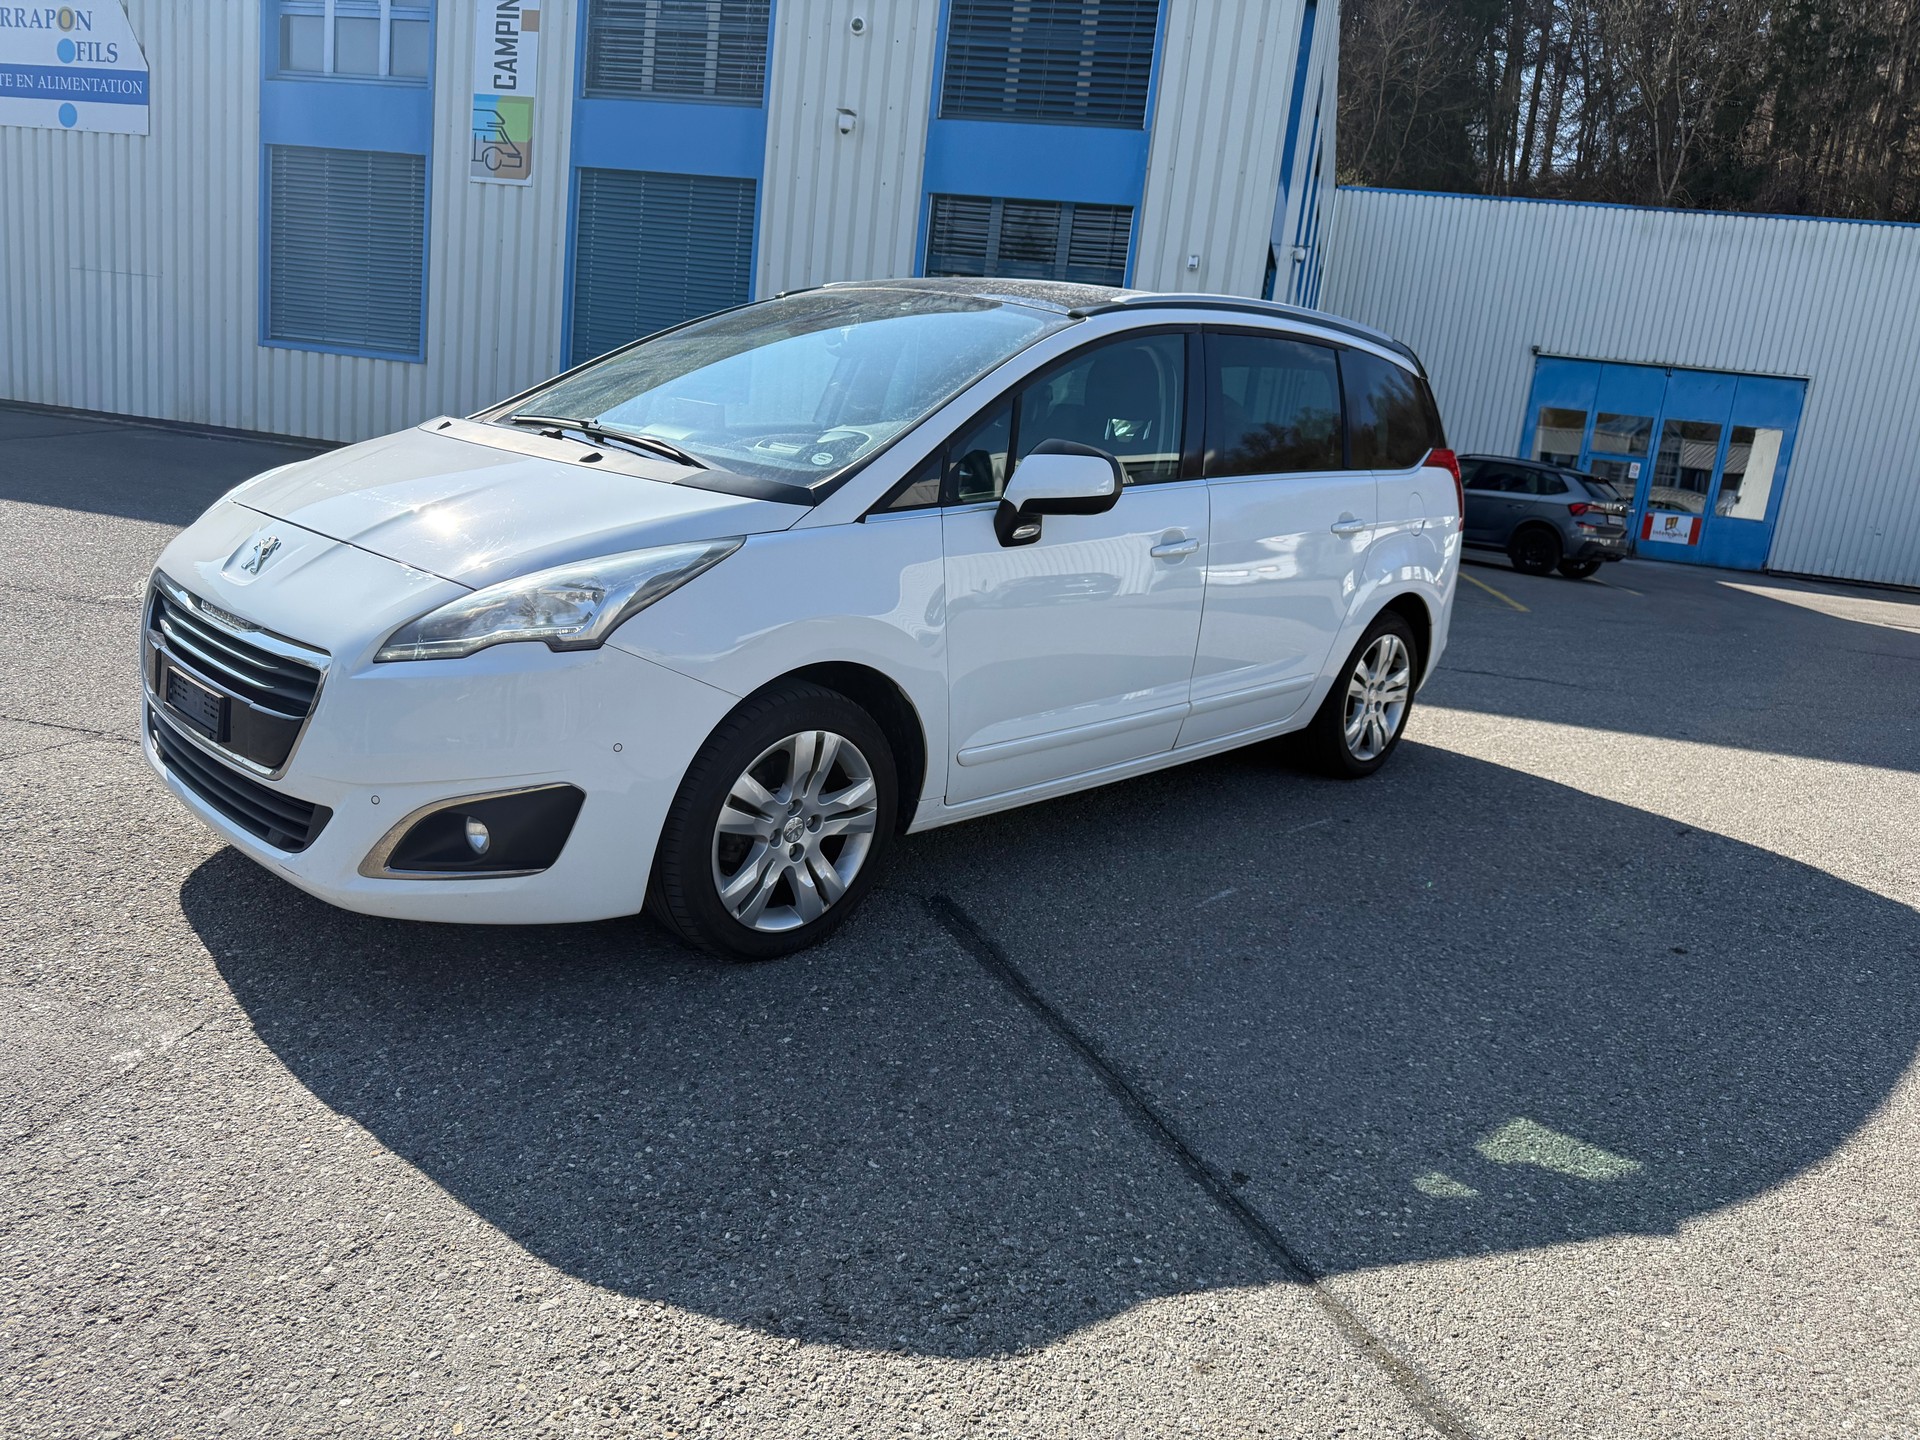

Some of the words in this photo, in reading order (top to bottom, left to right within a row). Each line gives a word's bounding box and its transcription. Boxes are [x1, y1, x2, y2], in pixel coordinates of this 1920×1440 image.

[0, 7, 92, 31] RRAPON
[75, 41, 118, 63] FILS
[16, 74, 34, 88] EN
[38, 75, 143, 94] ALIMENTATION
